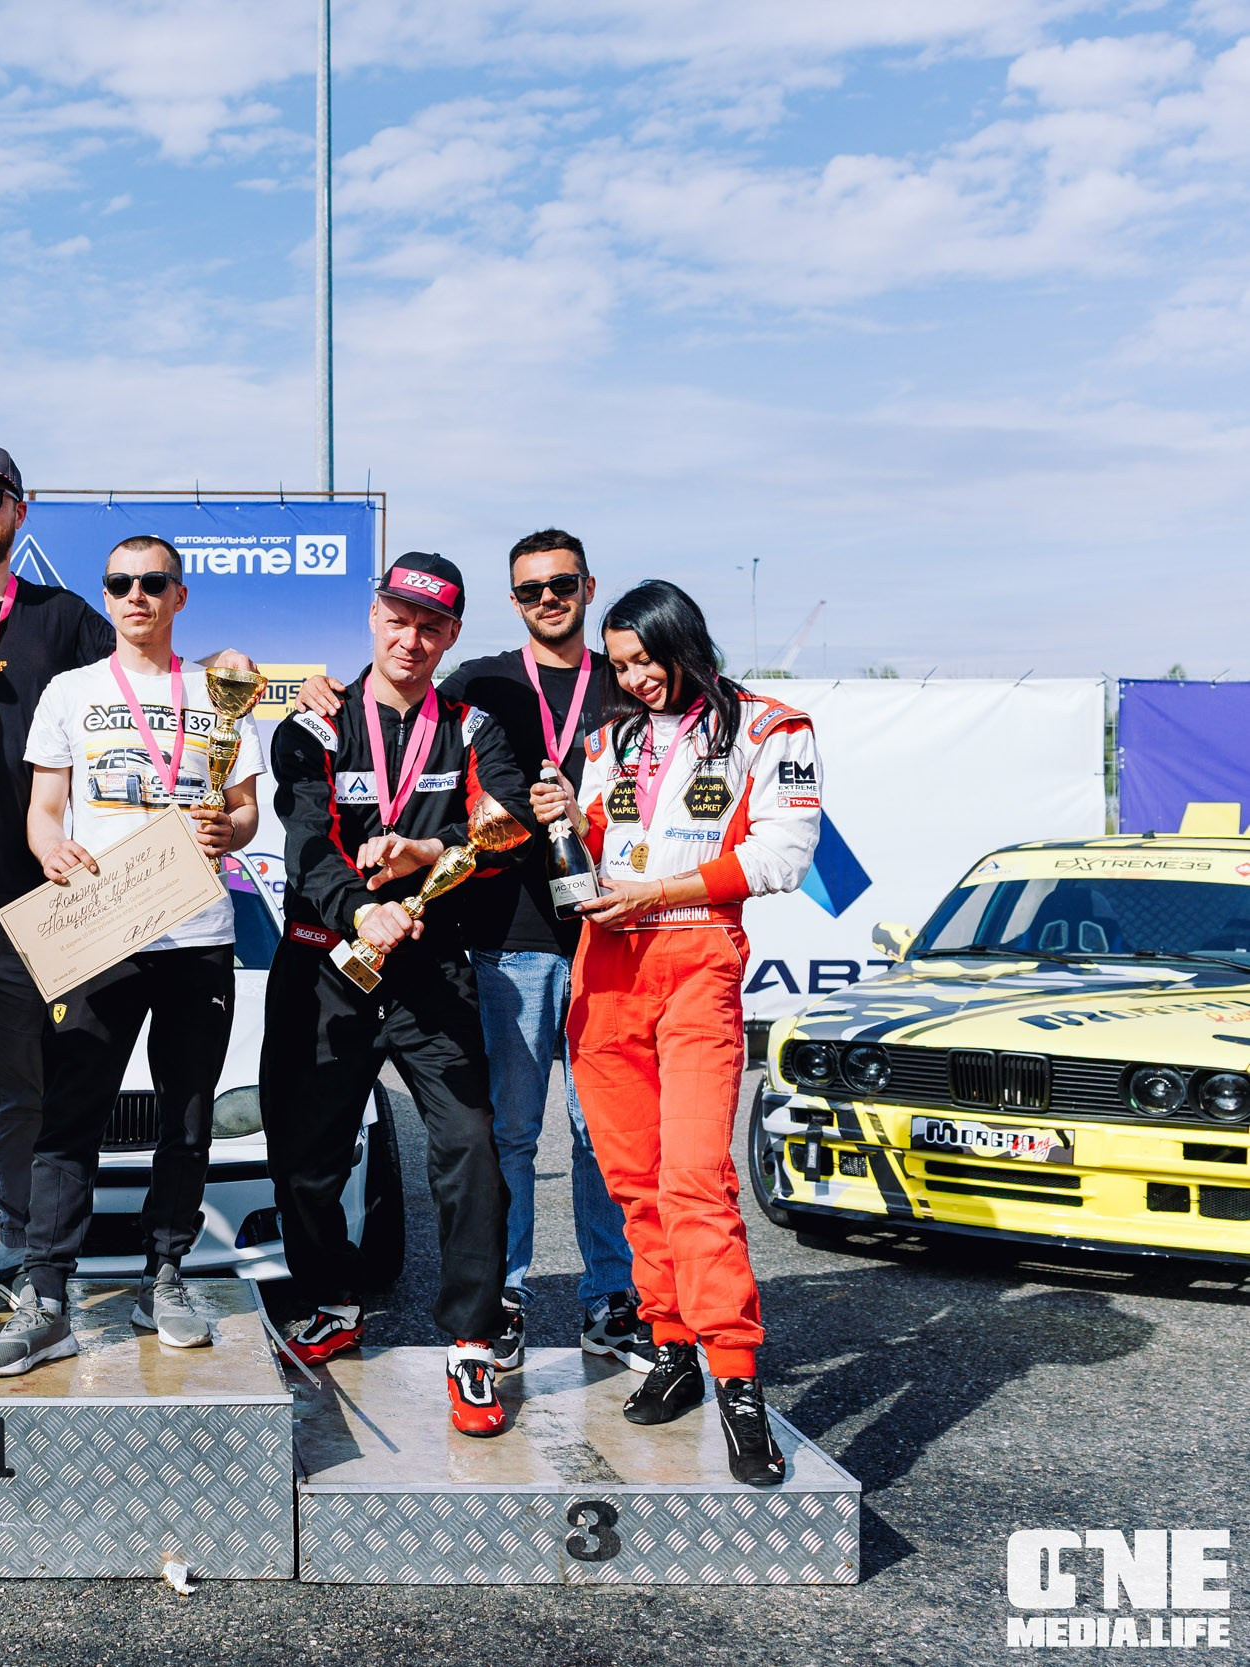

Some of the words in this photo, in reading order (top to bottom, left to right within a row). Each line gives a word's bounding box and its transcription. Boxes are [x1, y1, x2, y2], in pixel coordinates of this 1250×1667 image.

[174, 536, 256, 544] АВТОМОБИЛЬНЫЙ
[260, 536, 291, 544] СПОРТ
[303, 543, 339, 568] 39
[402, 572, 446, 595] RDS
[189, 715, 211, 732] 39
[1054, 857, 1212, 875] EXTREME39
[554, 880, 588, 893] ИСТОК
[294, 927, 328, 943] sparco
[566, 1500, 622, 1562] 3
